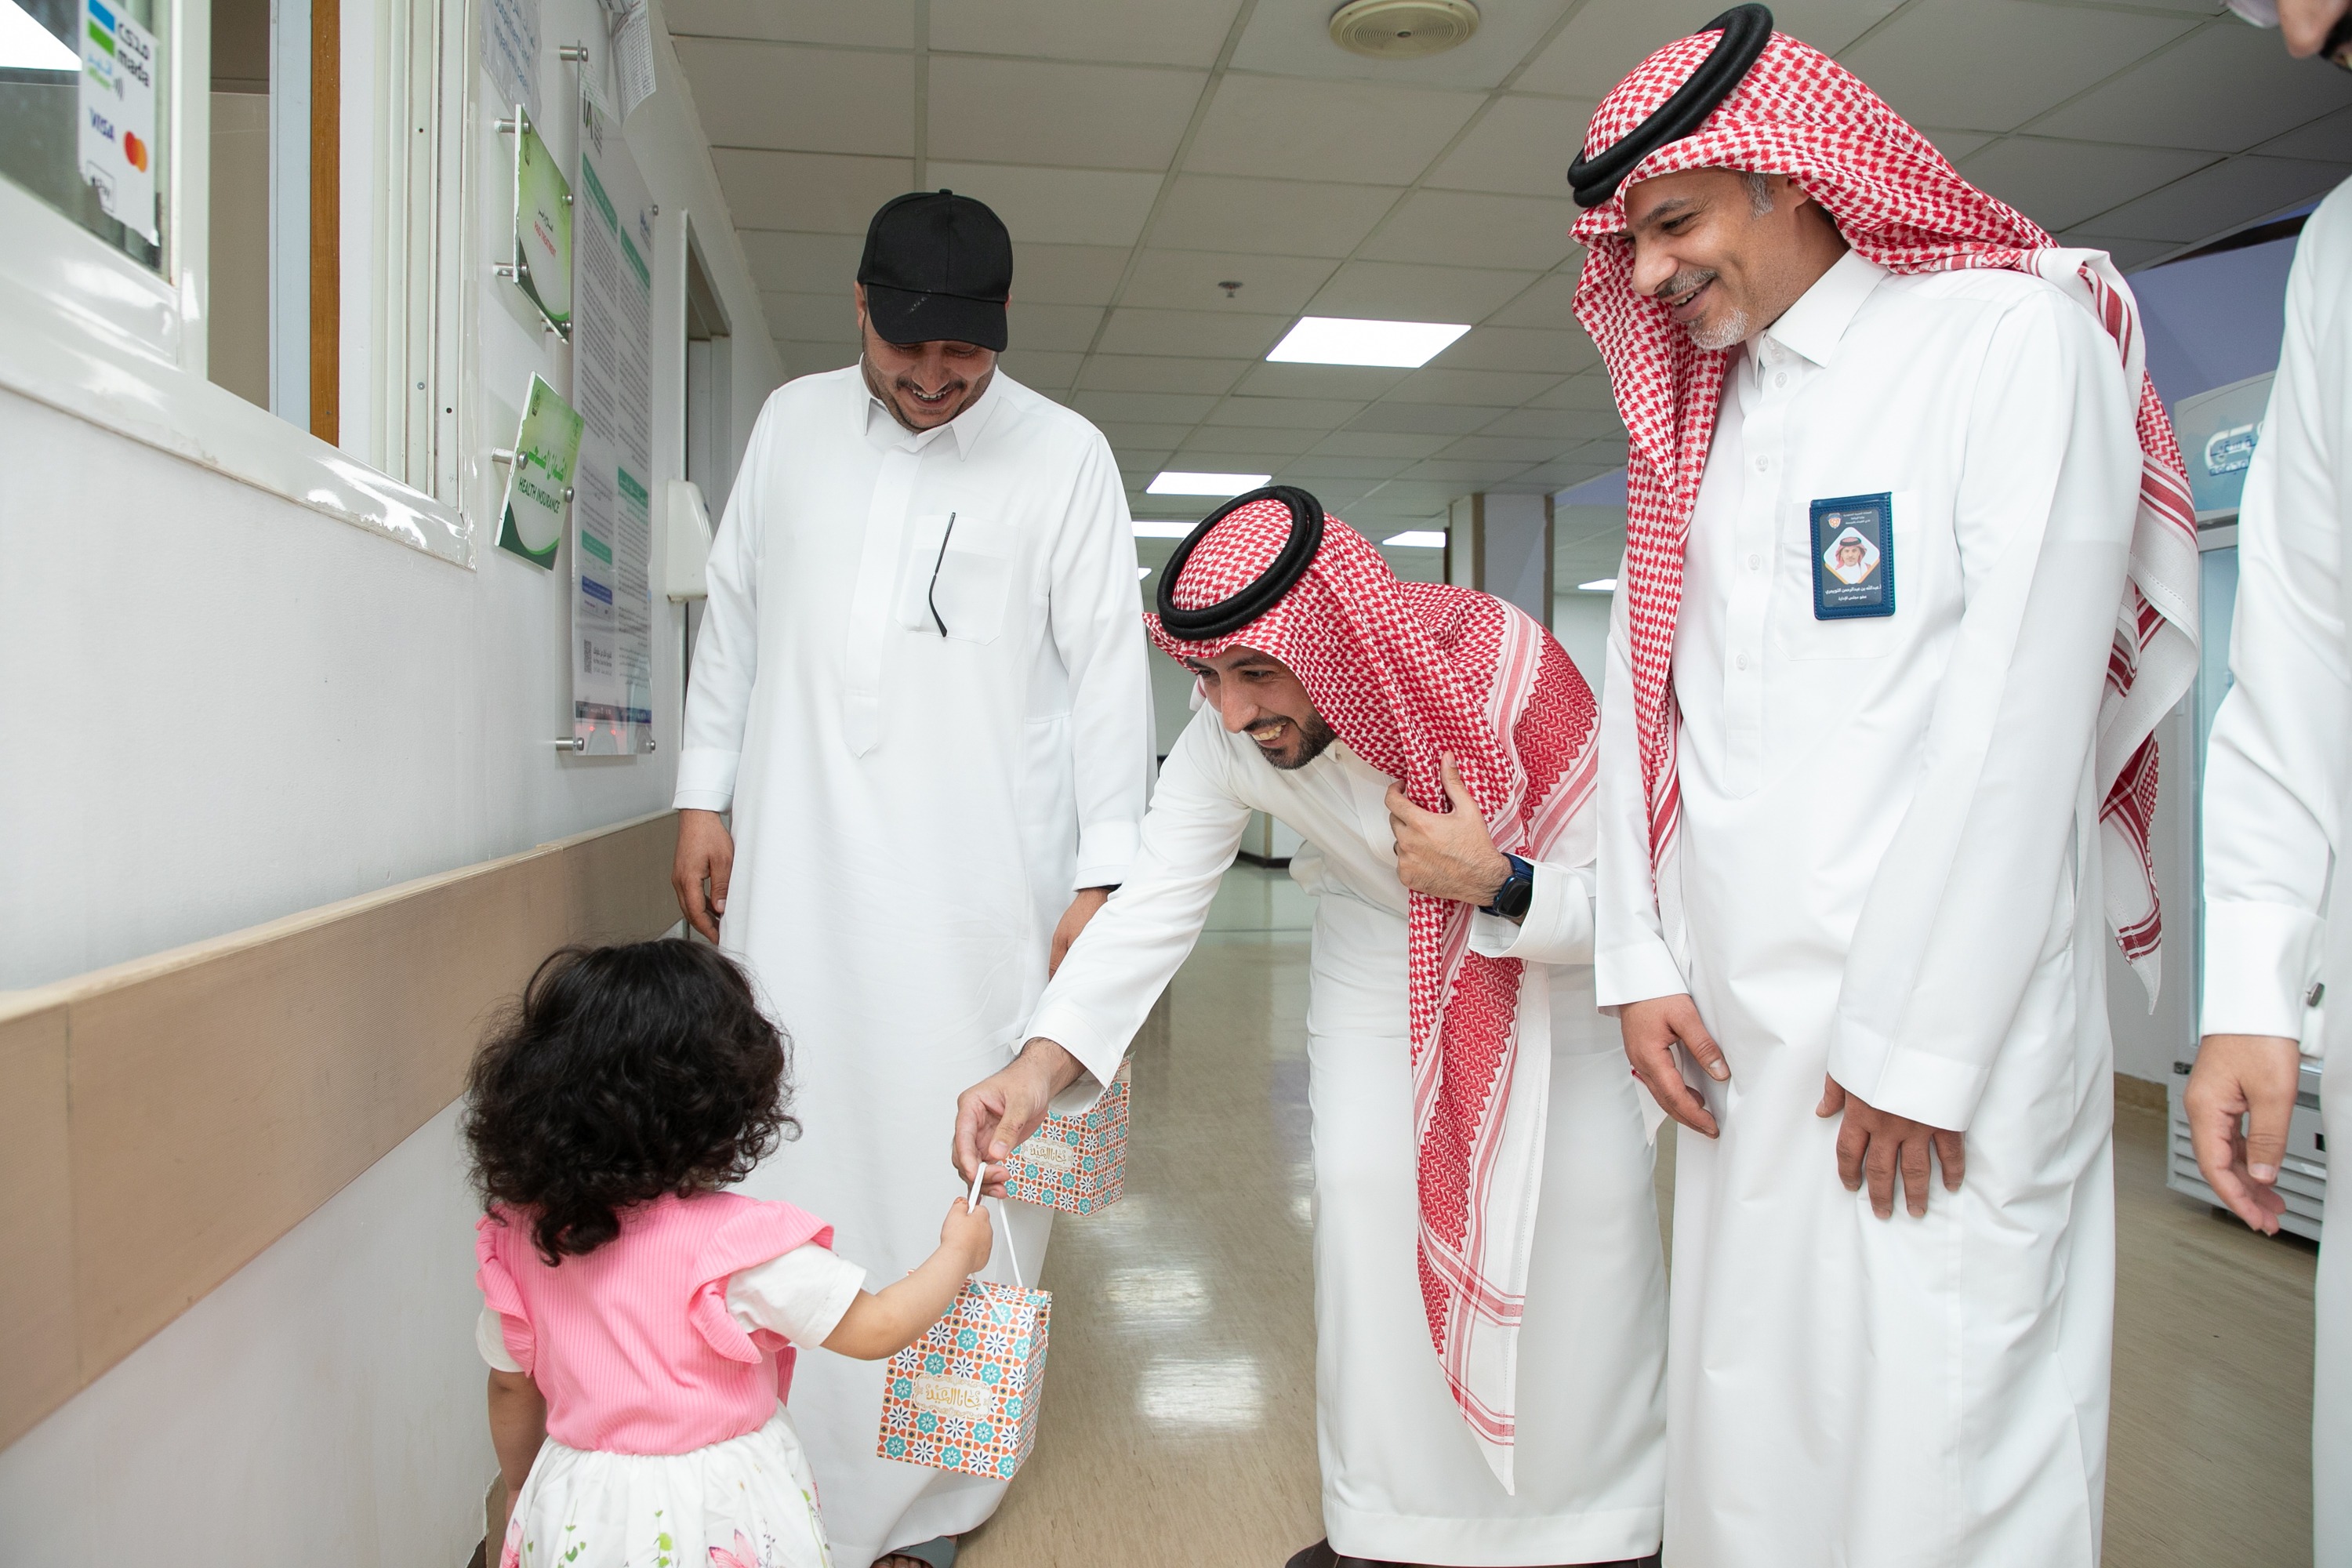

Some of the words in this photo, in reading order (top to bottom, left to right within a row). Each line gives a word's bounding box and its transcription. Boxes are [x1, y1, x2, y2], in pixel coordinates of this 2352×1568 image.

[118, 49, 149, 87] mada
[89, 107, 115, 143] VISA
[517, 477, 537, 502] HEALTH
[536, 487, 561, 514] INSURANCE
[926, 1384, 957, 1405] العيد
